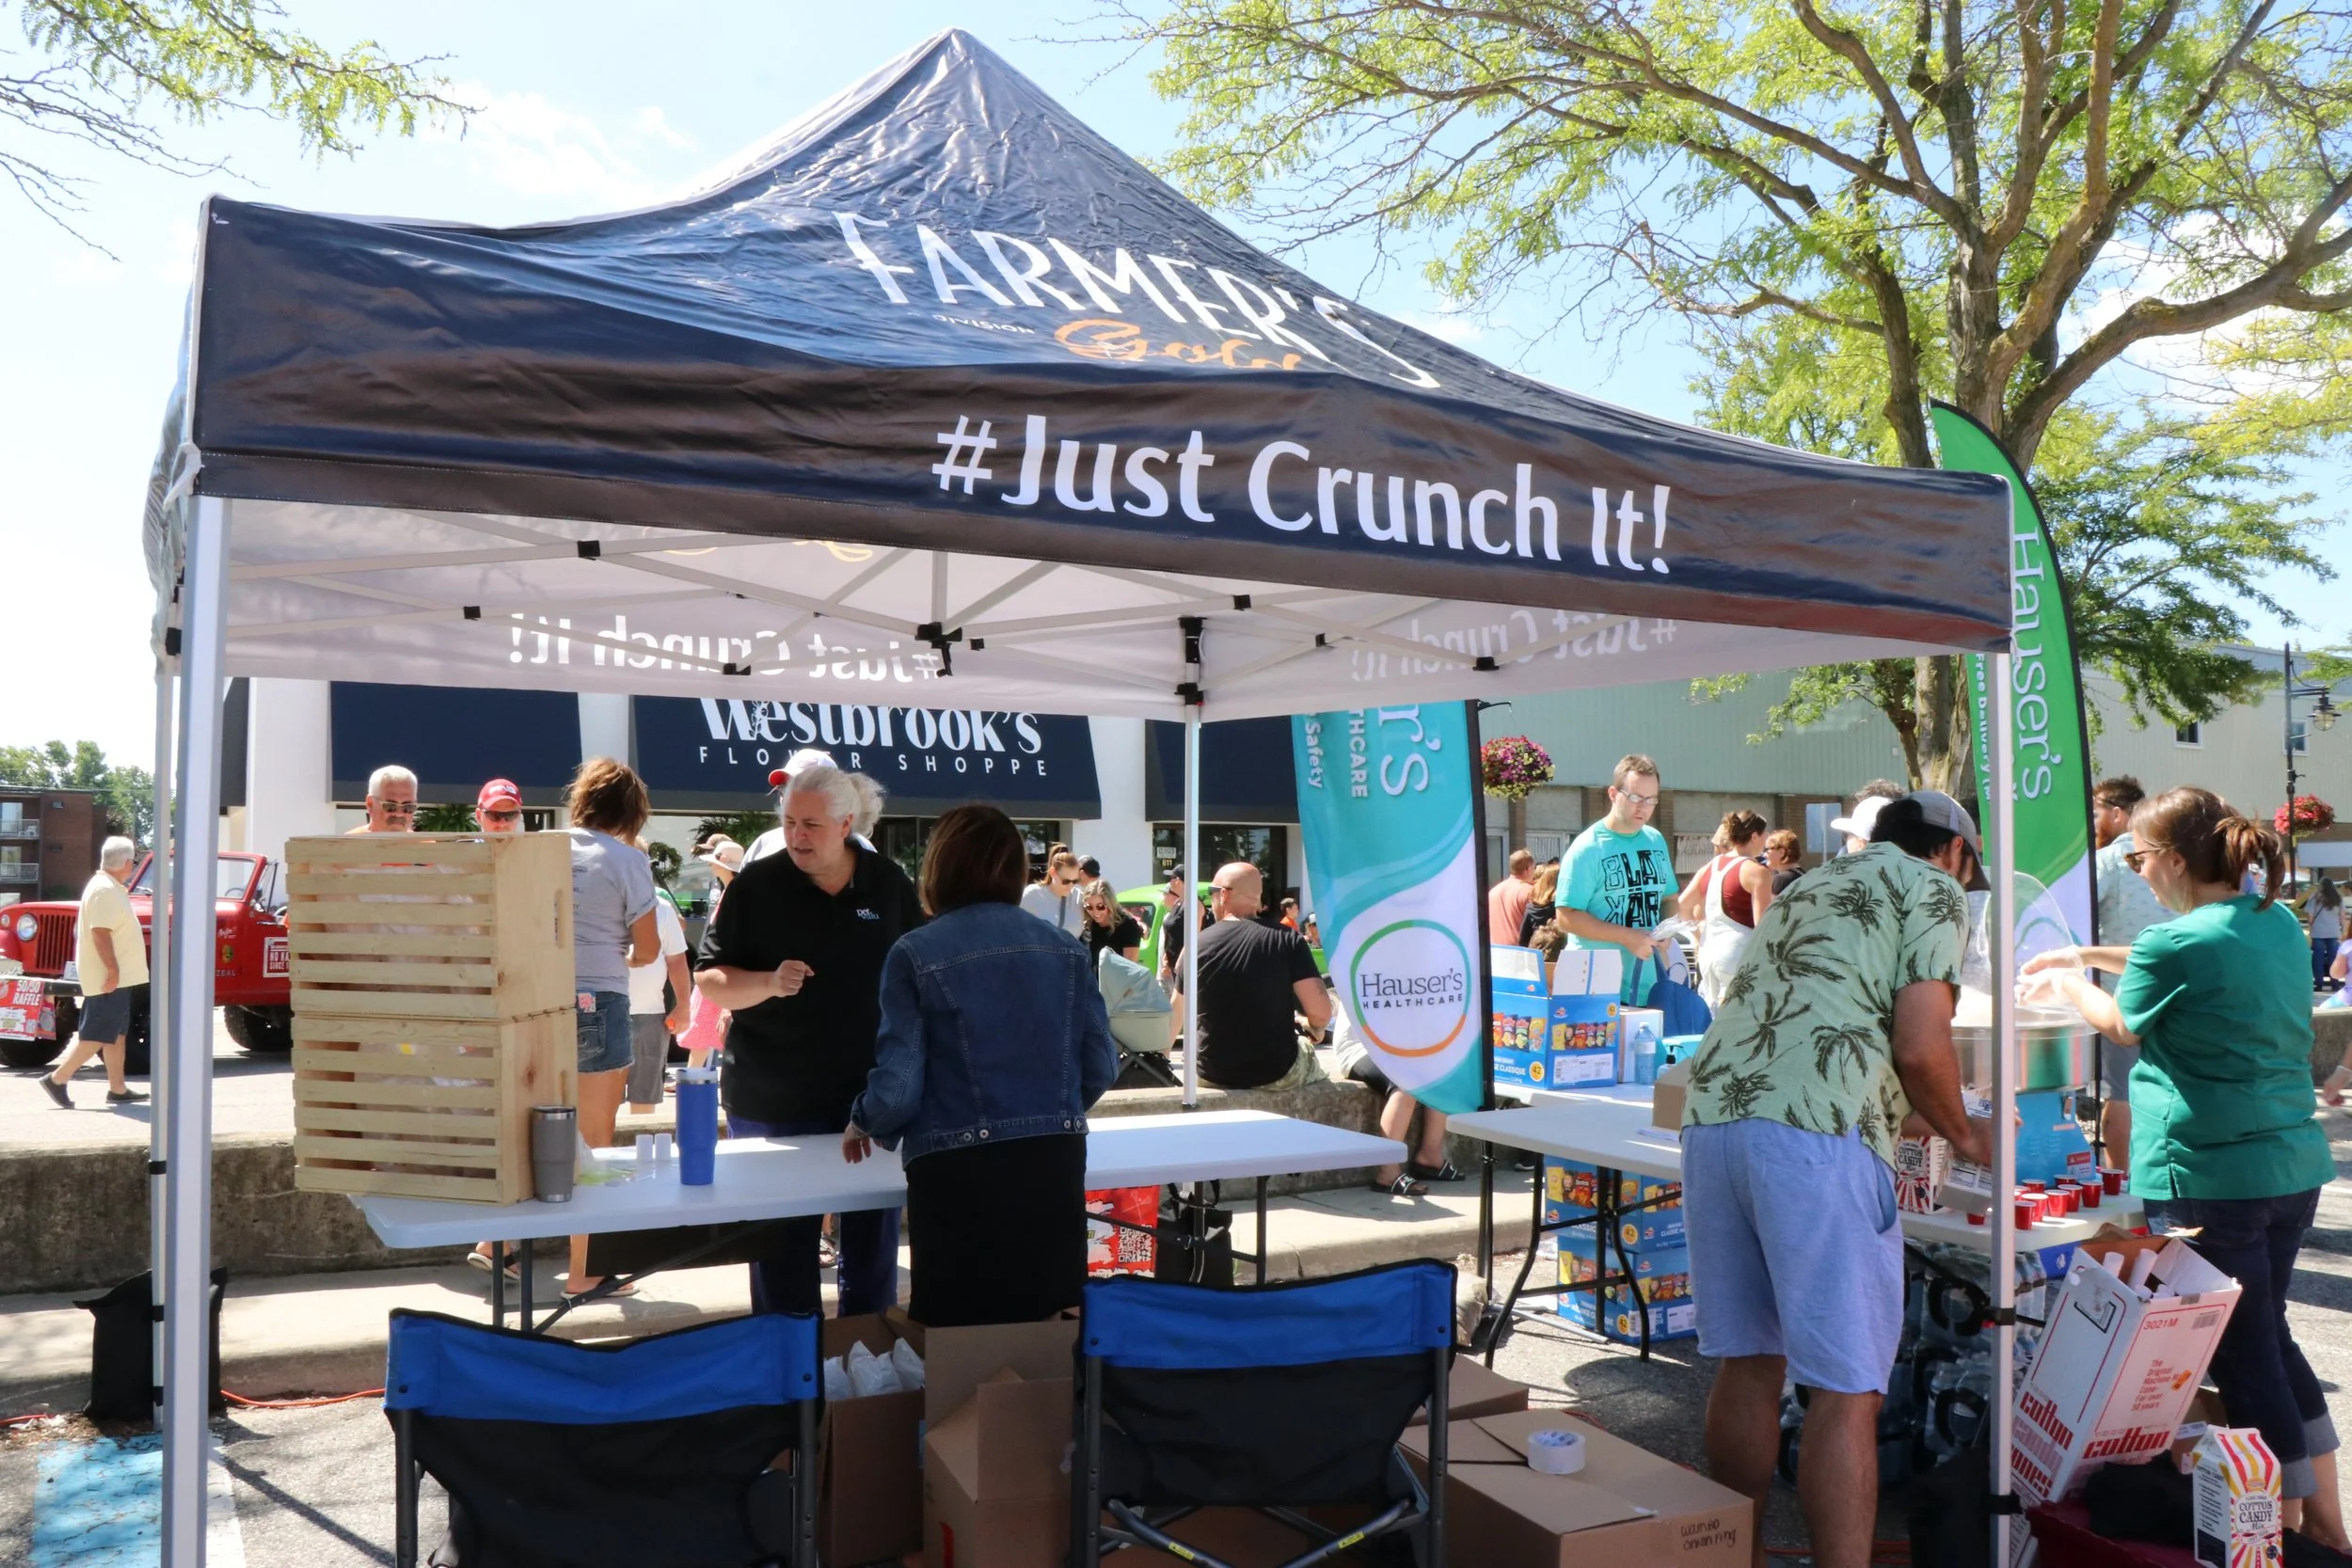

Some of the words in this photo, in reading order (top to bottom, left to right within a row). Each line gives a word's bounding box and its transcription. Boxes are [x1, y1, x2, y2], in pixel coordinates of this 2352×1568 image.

[833, 211, 1440, 388] FARMER'S
[931, 414, 1216, 523] #Just
[1248, 439, 1562, 562] Crunch
[1590, 484, 1672, 575] It!
[1976, 653, 1986, 691] Free
[2012, 527, 2062, 800] Hauser's
[699, 698, 1042, 753] Westbrook's
[1978, 697, 1991, 773] Delivery
[700, 746, 863, 769] FLOR
[898, 753, 1047, 776] SHOPPE
[1305, 722, 1325, 788] Safety
[1347, 709, 1368, 799] THCARE
[12, 992, 41, 1006] RAFFLE
[1360, 968, 1463, 997] Hauser's
[1362, 993, 1463, 1009] HEALTHCARE
[2019, 1391, 2074, 1450] cotton
[2082, 1426, 2170, 1459] cotton
[2239, 1500, 2273, 1512] COTTON
[2239, 1510, 2273, 1524] CANDY
